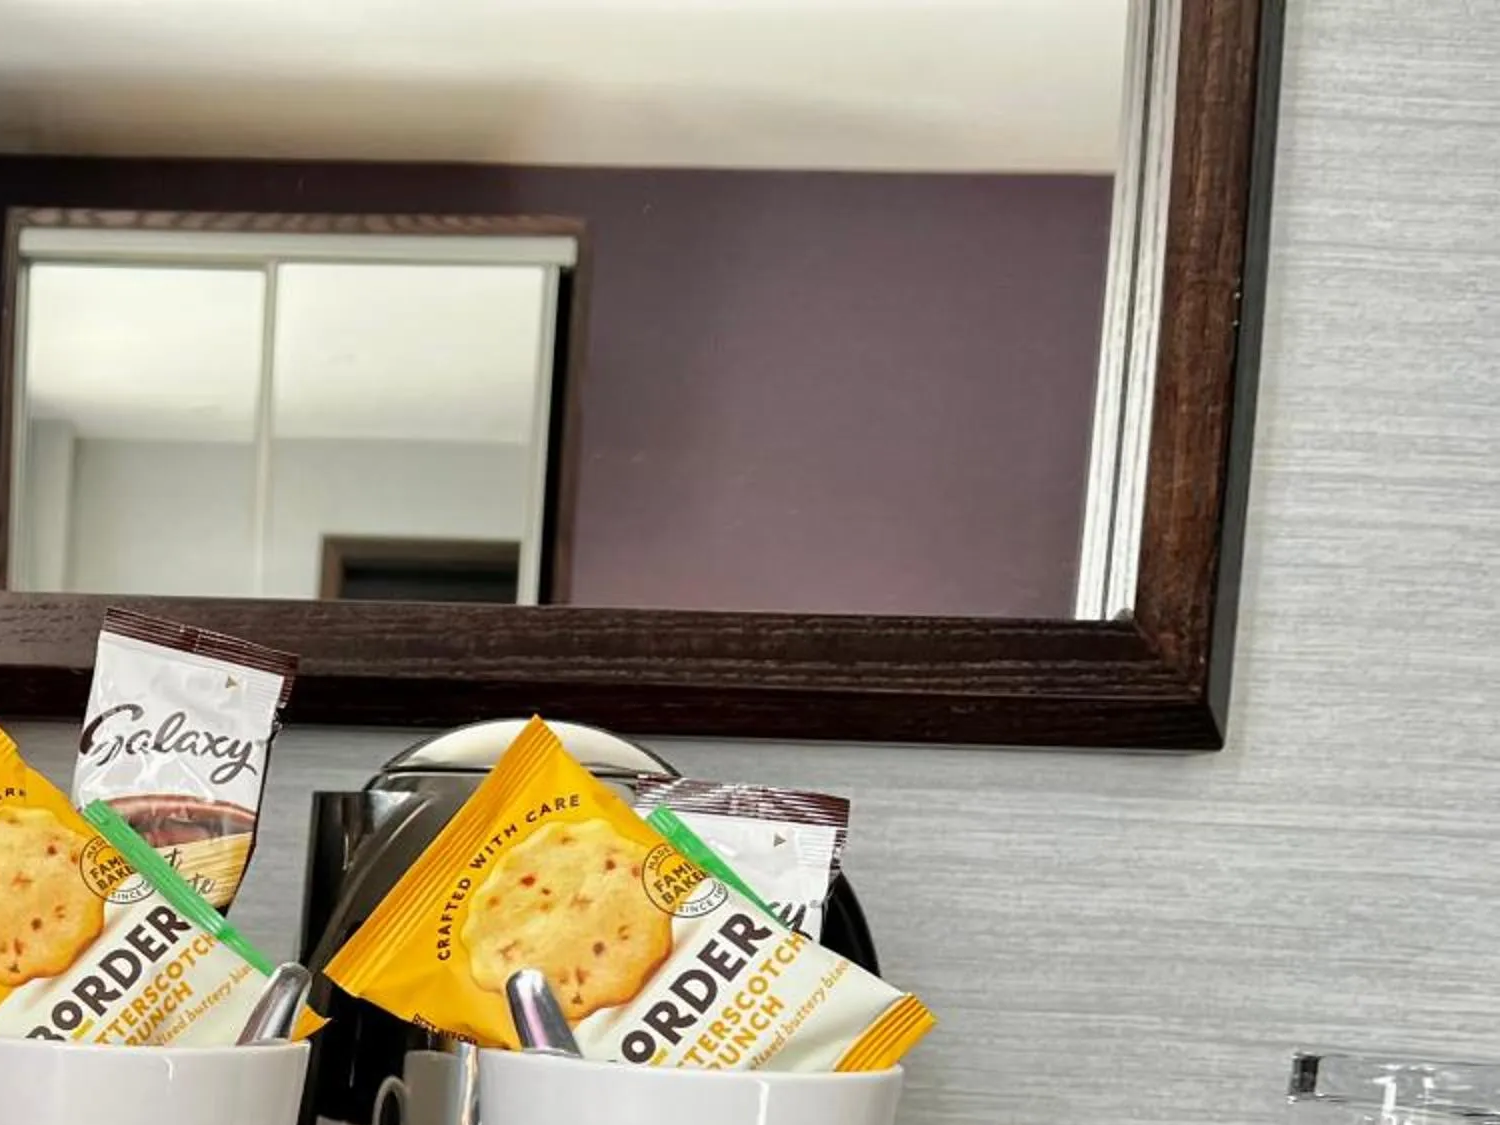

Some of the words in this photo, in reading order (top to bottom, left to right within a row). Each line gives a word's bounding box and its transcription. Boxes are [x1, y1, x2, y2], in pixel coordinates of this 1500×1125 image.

[80, 704, 257, 784] Galaxy
[436, 877, 472, 961] CRAFTED
[469, 823, 518, 870] WITH
[525, 794, 581, 824] CARE
[677, 933, 807, 1069] TERSCOTCH
[707, 995, 785, 1069] UNCH
